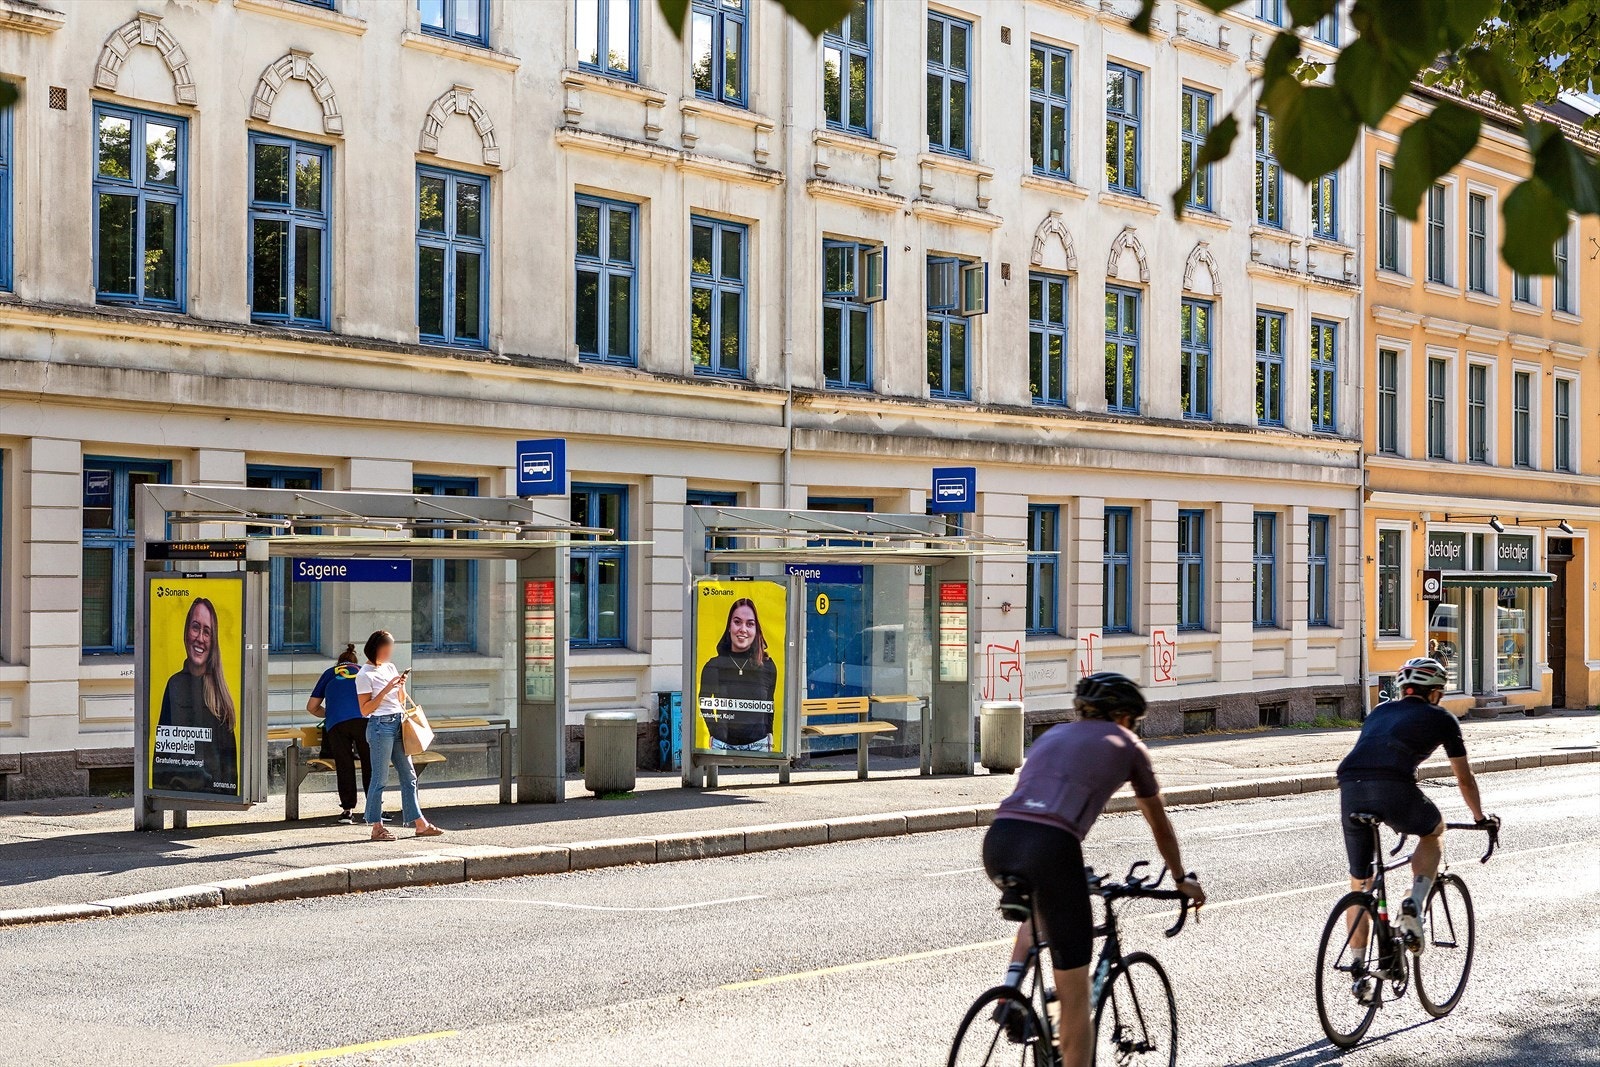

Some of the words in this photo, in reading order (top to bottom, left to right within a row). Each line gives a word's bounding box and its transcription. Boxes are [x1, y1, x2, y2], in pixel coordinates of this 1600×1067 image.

[1428, 540, 1461, 561] detaljer
[1498, 543, 1529, 563] detaljer
[299, 561, 347, 580] Sagene
[164, 587, 190, 597] Sonans
[710, 587, 735, 596] Sonans
[819, 597, 826, 610] B
[699, 697, 712, 707] Fra
[714, 698, 719, 707] 3
[728, 700, 733, 708] 6
[156, 726, 170, 737] Fra
[172, 726, 204, 740] dropout
[156, 739, 195, 752] sykepleie
